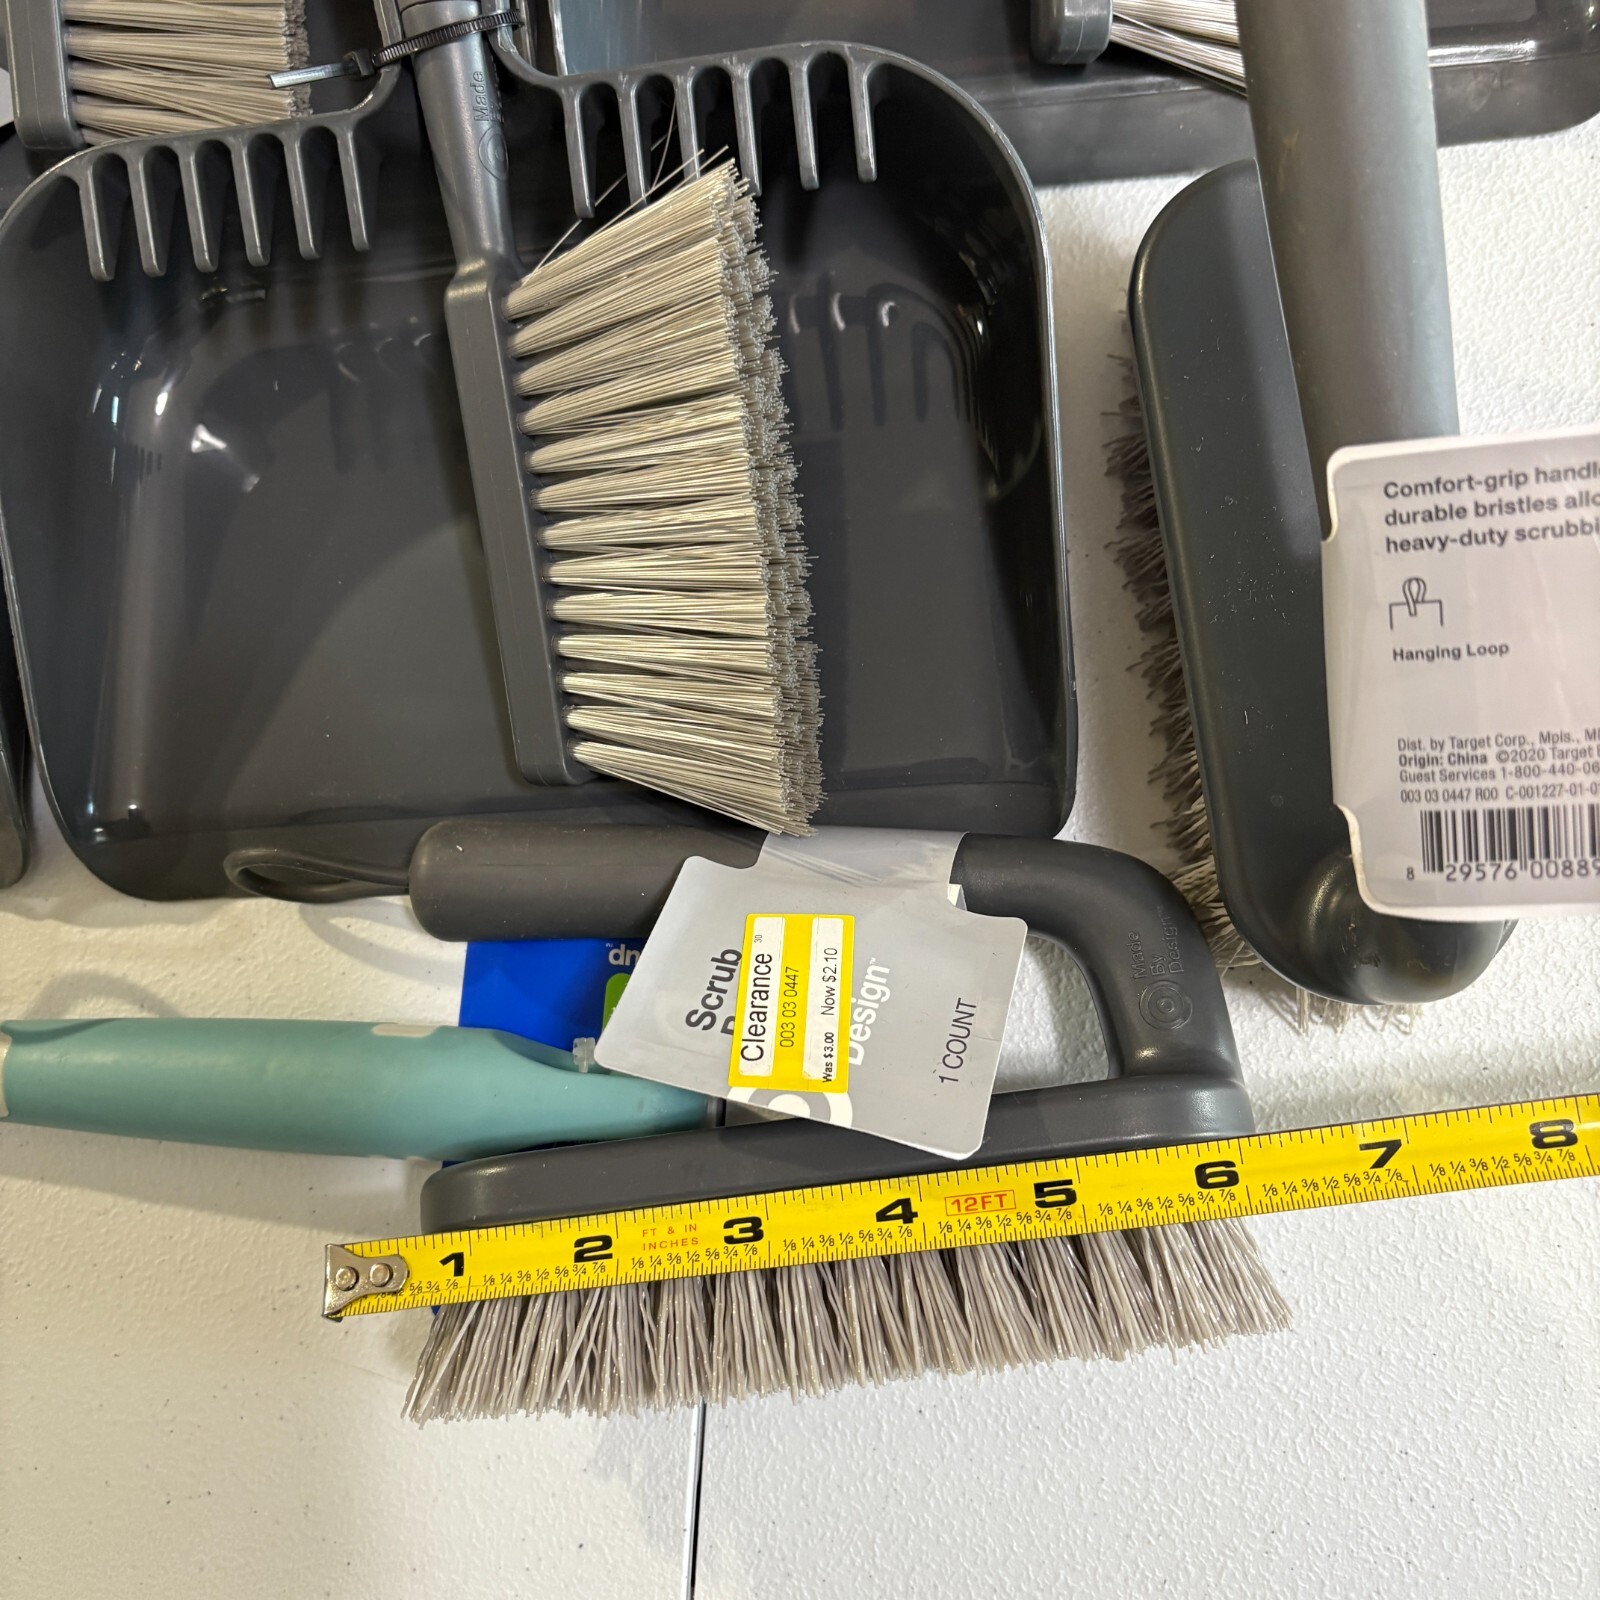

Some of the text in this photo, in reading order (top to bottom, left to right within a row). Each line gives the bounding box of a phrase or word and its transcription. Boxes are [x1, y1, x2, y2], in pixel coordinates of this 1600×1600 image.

[470, 71, 489, 122] Made
[1384, 461, 1600, 500] Comfort-grip handl
[1385, 504, 1468, 526] durable
[1474, 496, 1558, 518] bristles
[1386, 528, 1508, 554] heavy-duty
[1392, 642, 1510, 662] Hanging Loop
[1398, 738, 1426, 751] Dist.
[1430, 736, 1445, 750] by
[1450, 734, 1491, 750] Target
[1399, 754, 1443, 768] Origin:
[1448, 752, 1488, 766] China
[1549, 745, 1594, 761] Target
[1400, 770, 1436, 783] Guest
[1440, 767, 1496, 782] Services
[1400, 782, 1600, 803] 003 03 0447 R00 C-001227-01-0
[1406, 866, 1415, 881] 8
[1445, 863, 1518, 882] 29576
[754, 934, 762, 944] 30
[1161, 916, 1184, 974] Design
[1127, 931, 1148, 980] Made
[1150, 954, 1166, 976] By
[685, 949, 742, 1031] Scrub
[740, 953, 772, 1062] Clearance
[780, 966, 800, 1048] 003 03 0447
[821, 948, 838, 1083] Was $3.00 Now $2.10
[939, 997, 976, 1084] 1 COUNT
[439, 1118, 1578, 1278] 1 2 3 4 5 6 7 8
[950, 1194, 1008, 1213] 12FT
[642, 1223, 698, 1238] FT & IN
[642, 1237, 699, 1250] INCHES
